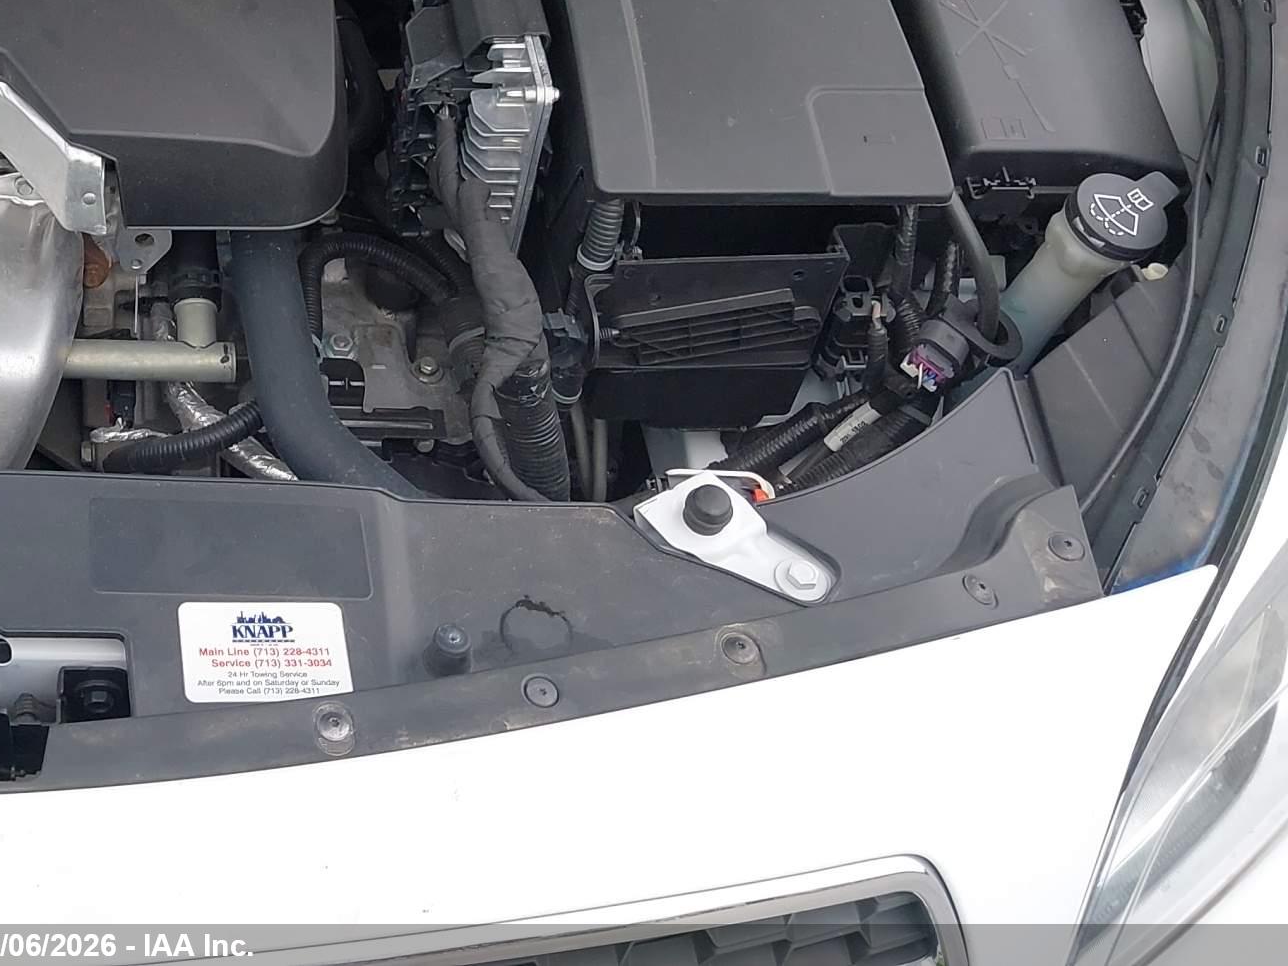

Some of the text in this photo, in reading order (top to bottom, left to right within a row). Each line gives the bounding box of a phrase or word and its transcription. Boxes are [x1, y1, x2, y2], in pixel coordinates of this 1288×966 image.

[231, 624, 294, 639] KNAPP
[199, 647, 330, 658] Main Line (713) 228-4311
[211, 658, 332, 669] Service (713) 331-3034
[250, 671, 278, 679] Towing
[217, 680, 234, 688] 6pm
[264, 679, 300, 687] Saturday
[310, 679, 340, 687] Sunday
[263, 687, 283, 695] (713)
